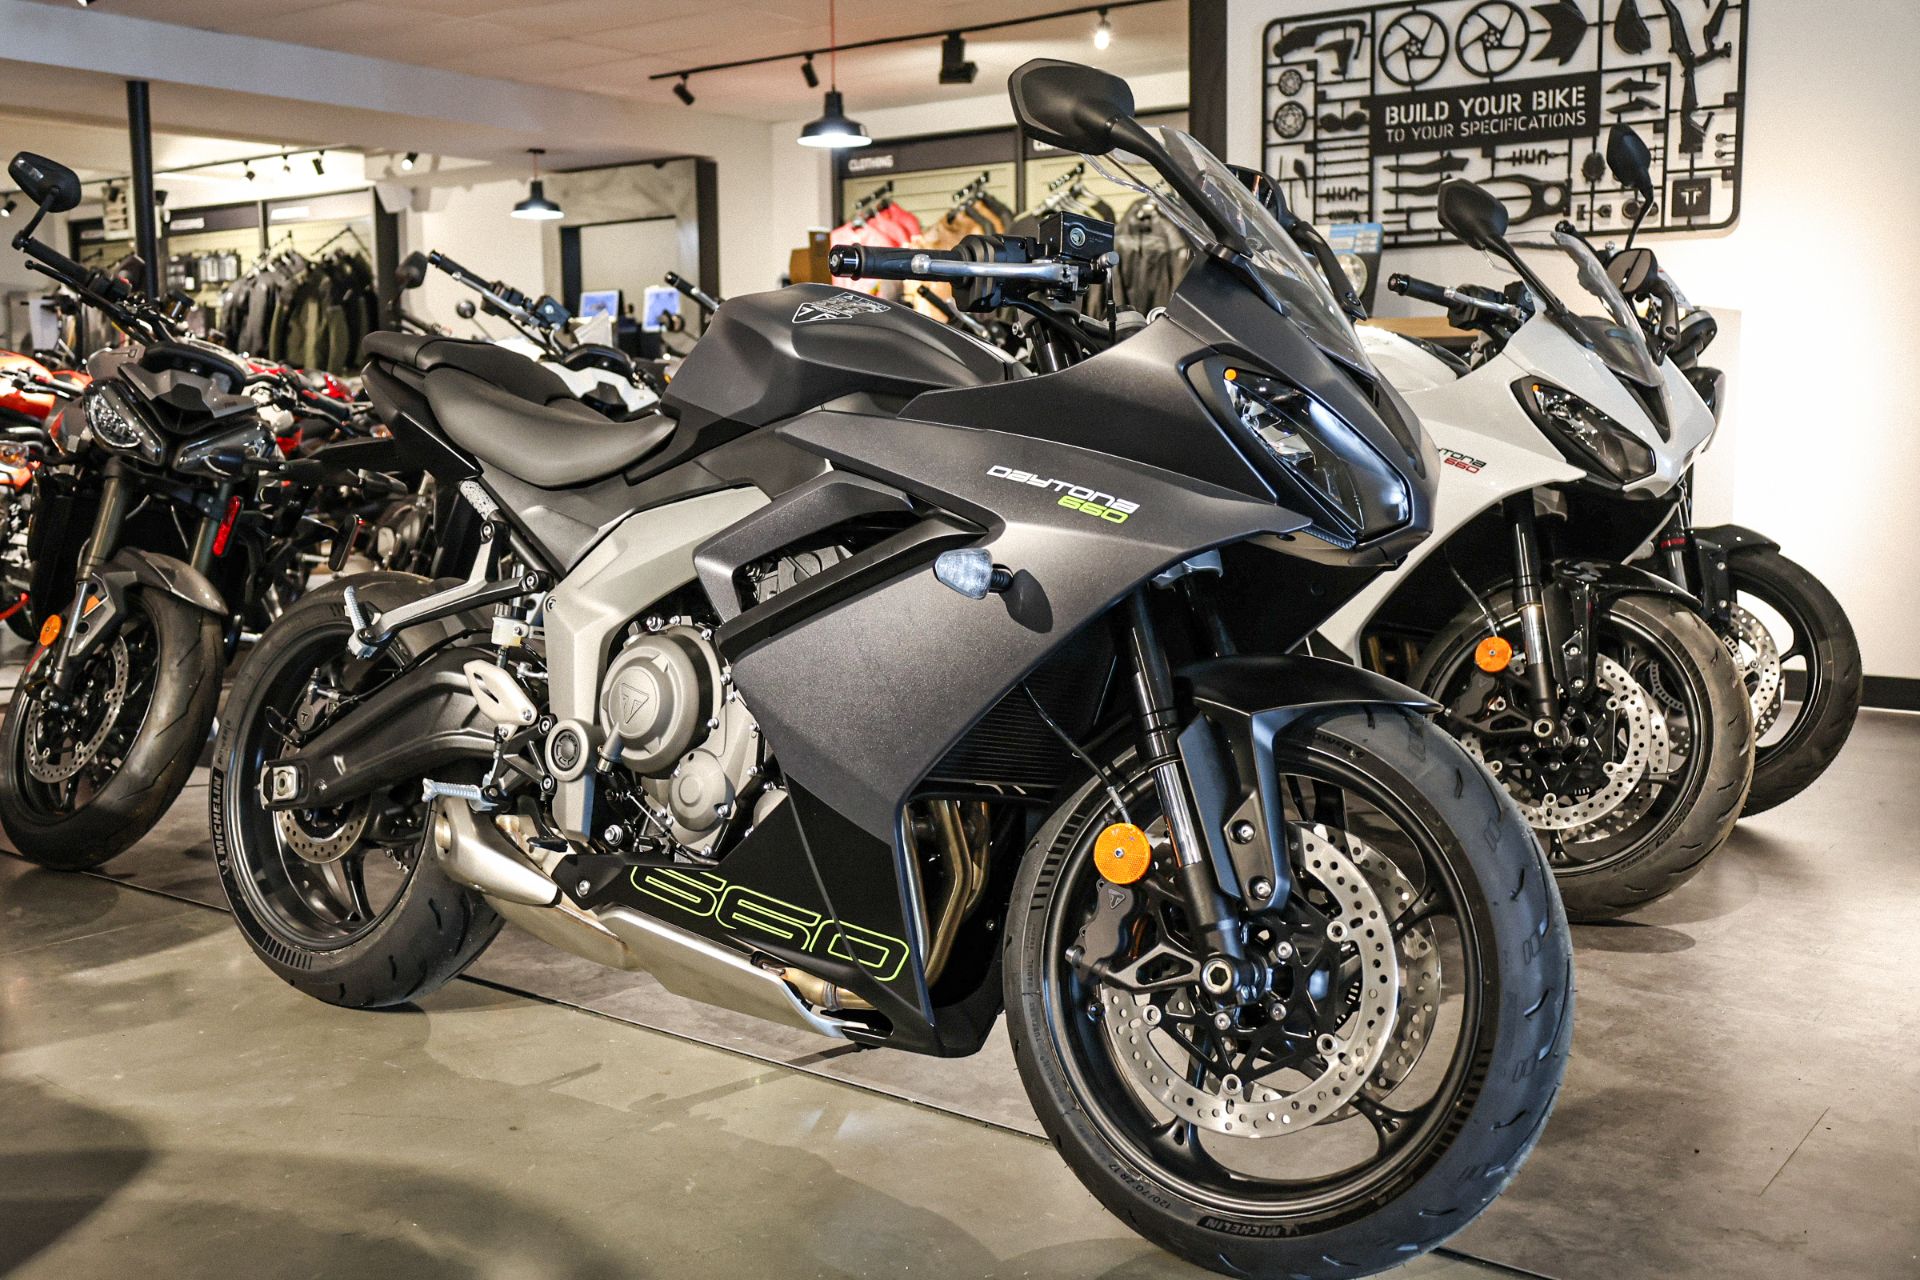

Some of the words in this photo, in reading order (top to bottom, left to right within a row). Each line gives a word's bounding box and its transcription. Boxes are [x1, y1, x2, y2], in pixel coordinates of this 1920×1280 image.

[1385, 101, 1449, 125] BUILD
[1459, 93, 1521, 117] YOUR
[1532, 86, 1586, 111] BIKE
[1386, 128, 1405, 142] TO
[1412, 123, 1454, 140] YOUR
[1460, 110, 1586, 137] SPECIFICATIONS
[848, 155, 894, 171] CLOTHING
[1444, 457, 1480, 473] 660
[1058, 495, 1129, 524] 660
[213, 776, 227, 855] MICHELIN
[630, 866, 910, 981] 660
[1205, 1217, 1282, 1237] MICHELIN
